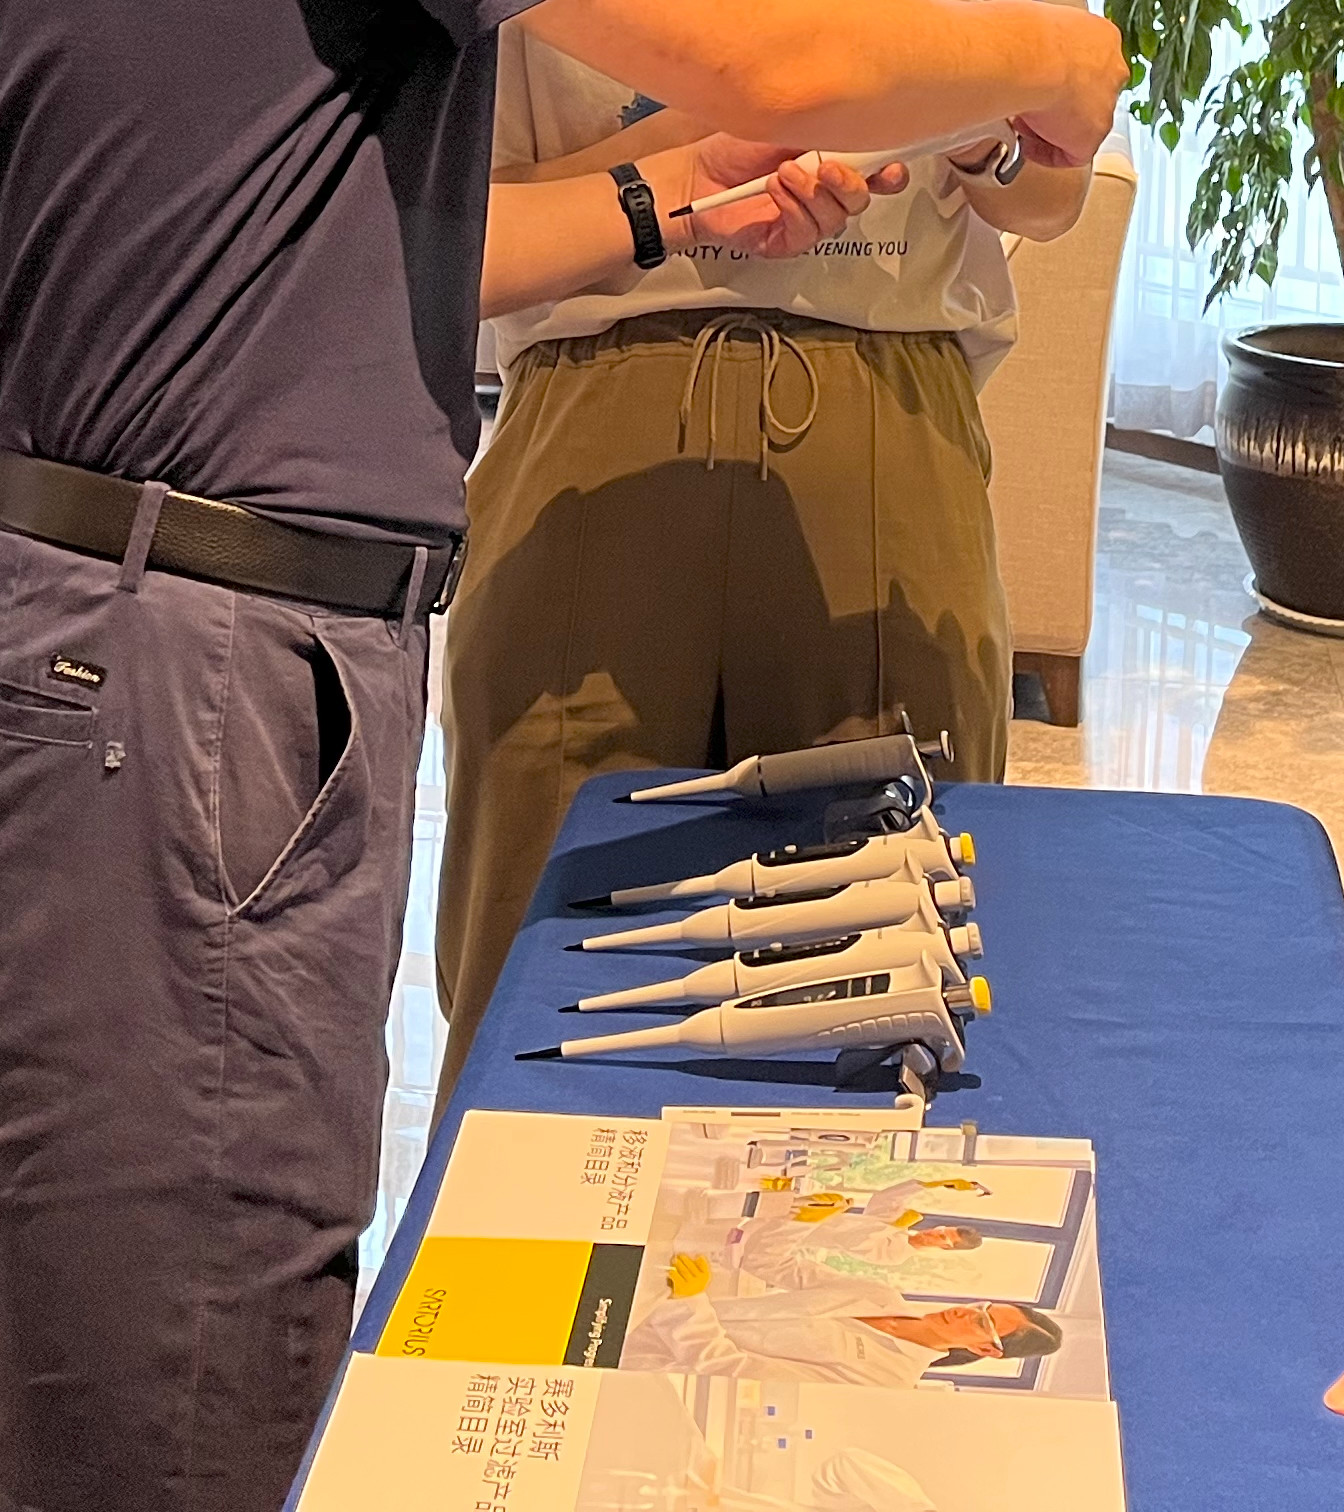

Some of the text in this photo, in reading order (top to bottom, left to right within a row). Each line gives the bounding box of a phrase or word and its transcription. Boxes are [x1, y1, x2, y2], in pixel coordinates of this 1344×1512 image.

[878, 241, 908, 255] YOU
[579, 1128, 618, 1185] 精简目录
[451, 1373, 501, 1455] 精简目录
[527, 1378, 575, 1461] 赛多利斯
